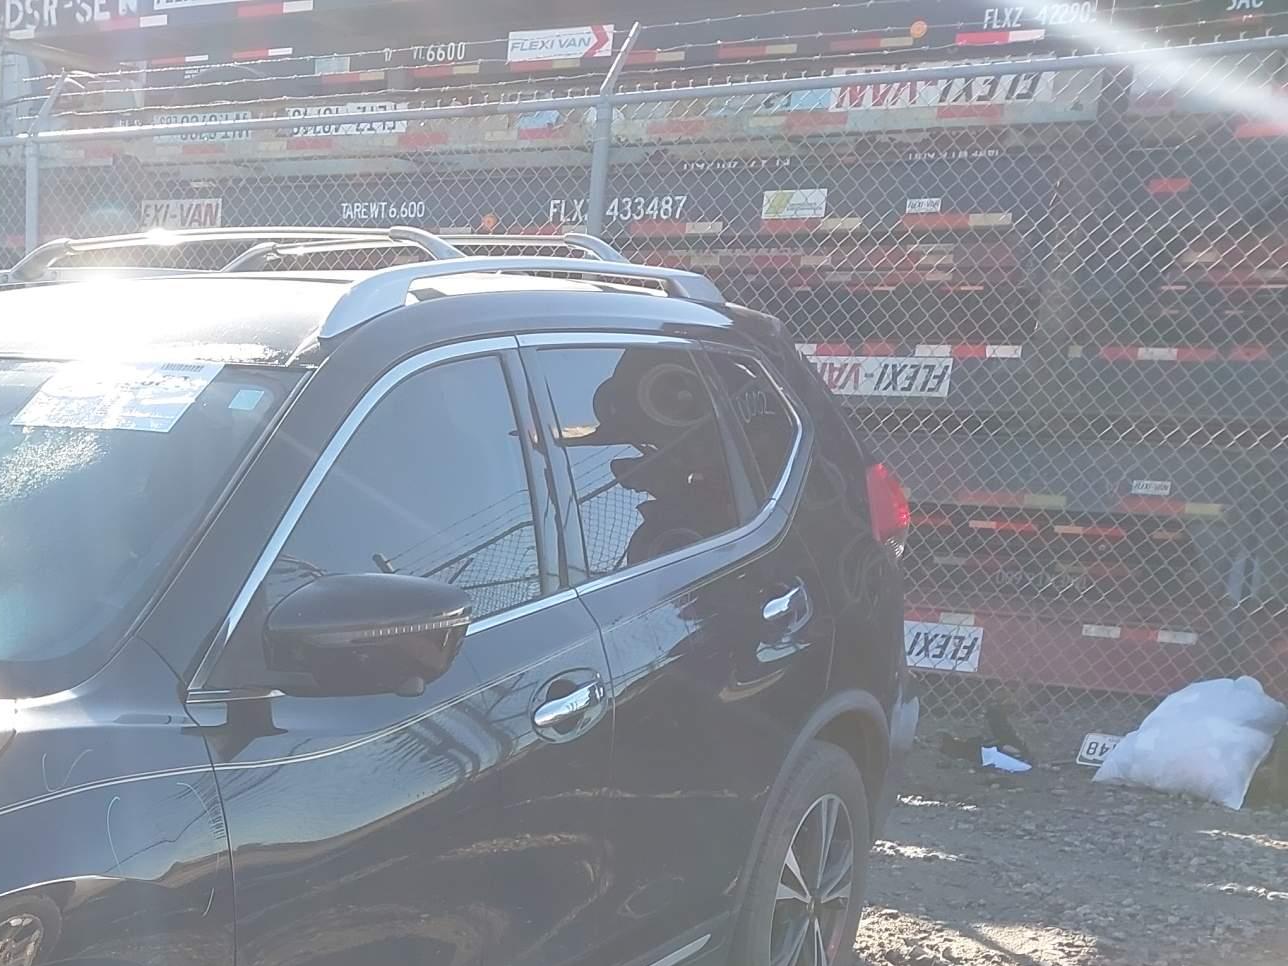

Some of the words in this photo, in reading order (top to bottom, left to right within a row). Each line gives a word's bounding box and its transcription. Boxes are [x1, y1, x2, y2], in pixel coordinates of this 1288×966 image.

[983, 7, 1024, 28] FLXZ
[1034, 1, 1097, 25] 42290
[511, 39, 554, 52] FLEXI
[555, 36, 592, 49] VAN
[549, 199, 590, 222] FLX
[606, 195, 688, 221] 433487
[817, 362, 949, 393] FLEXI-VA
[907, 631, 978, 662] FLEXI
